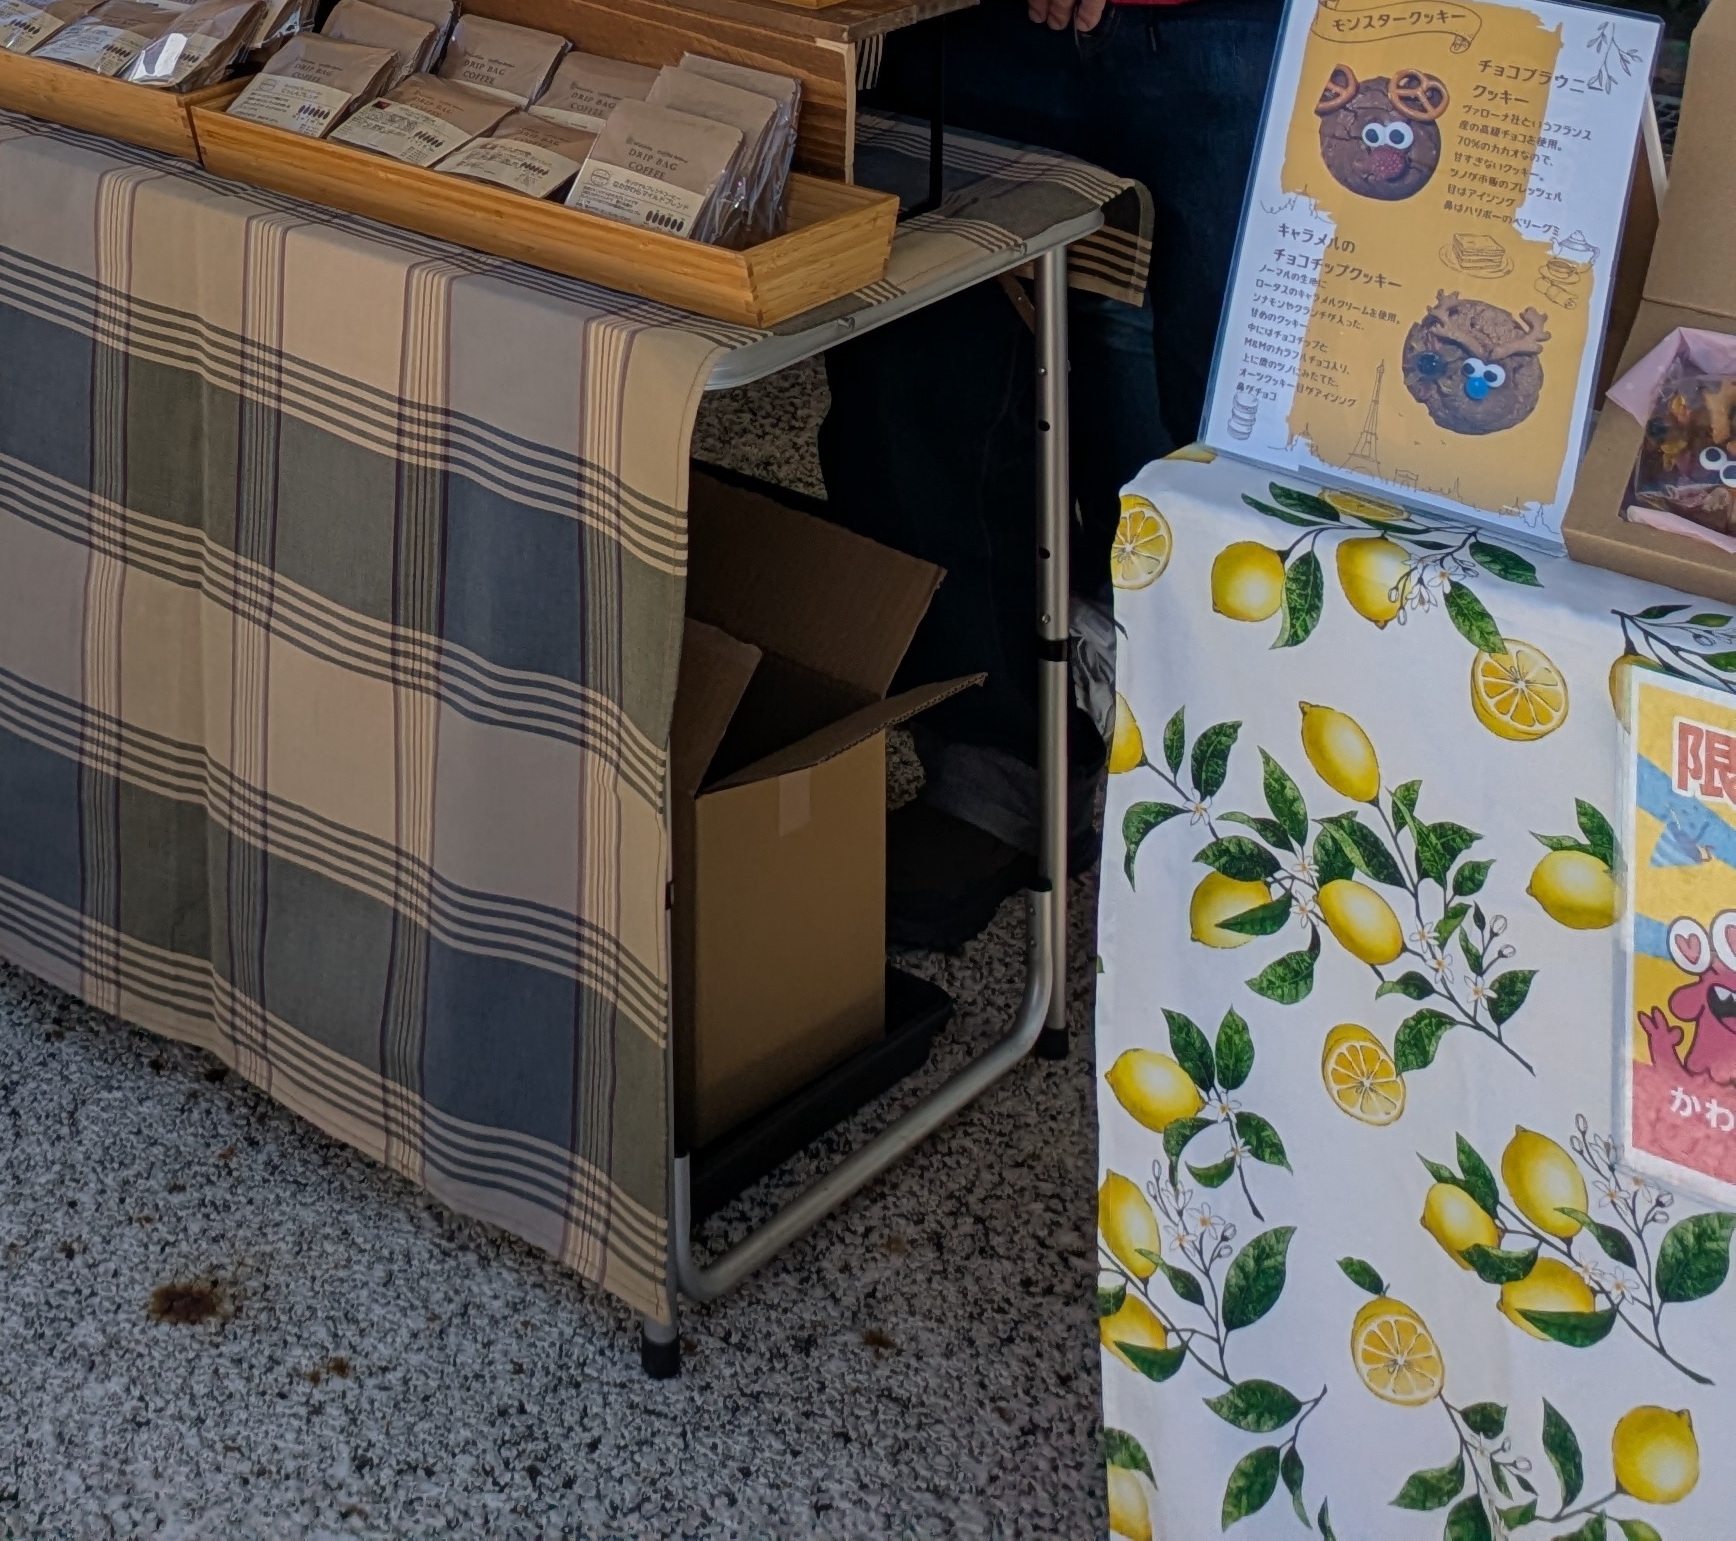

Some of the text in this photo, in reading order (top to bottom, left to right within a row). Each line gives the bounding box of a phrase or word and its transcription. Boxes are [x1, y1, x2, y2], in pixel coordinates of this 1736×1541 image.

[1332, 9, 1467, 32] モンスタークッキー
[1478, 59, 1604, 94] チョコブラウニー
[1472, 84, 1530, 105] クッキー
[1458, 119, 1563, 152] 産の高級チョコを使用。
[1462, 104, 1592, 141] ヴァローナ社というフランス
[628, 148, 654, 162] DRIP
[655, 158, 679, 171] BAG
[1454, 151, 1544, 182] 甘すぎないクッキー。
[1456, 135, 1554, 167] 70%のカカオなので、
[1447, 183, 1516, 208] 目はアイシング
[1444, 200, 1560, 237] 鼻はハリボーのベリーグミ
[1278, 223, 1356, 254] キャラメルの
[1259, 264, 1327, 289] ノーマルの生地に
[1273, 248, 1402, 289] チョコチップクッキー
[1255, 278, 1401, 325] ロータスのキャラメルクリームを使用。
[1247, 322, 1329, 354] 中にはチョコチップと
